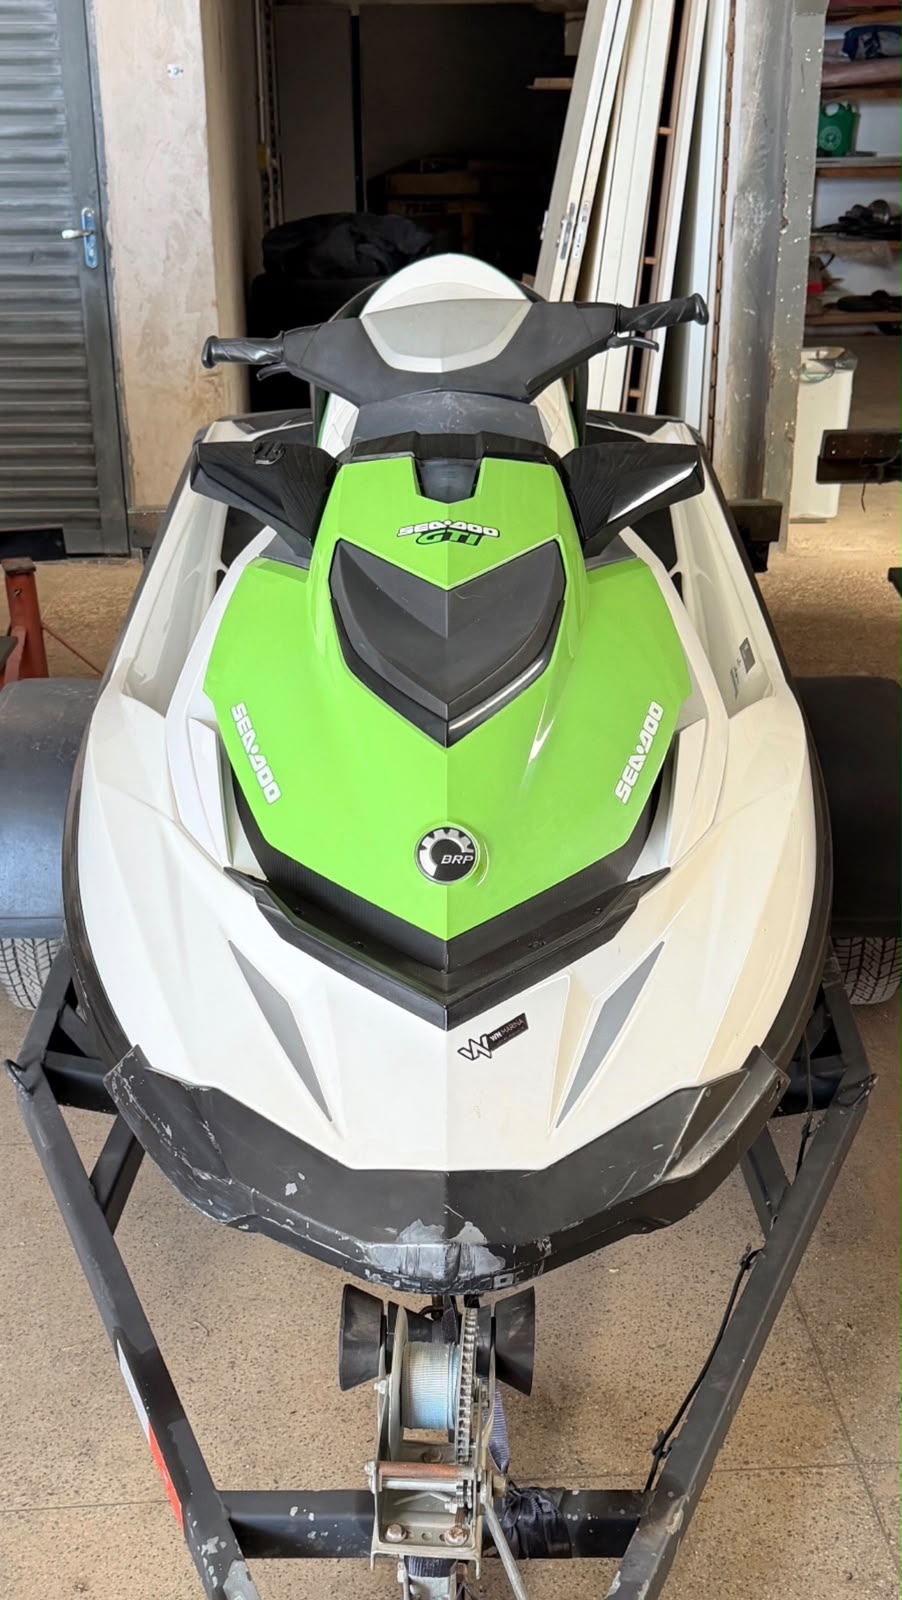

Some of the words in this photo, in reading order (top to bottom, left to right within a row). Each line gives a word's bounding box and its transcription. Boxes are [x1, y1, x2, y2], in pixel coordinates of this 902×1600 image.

[416, 529, 482, 546] GTI
[441, 854, 474, 865] BRP
[489, 1031, 503, 1042] WN
[500, 1018, 525, 1035] MARINA
